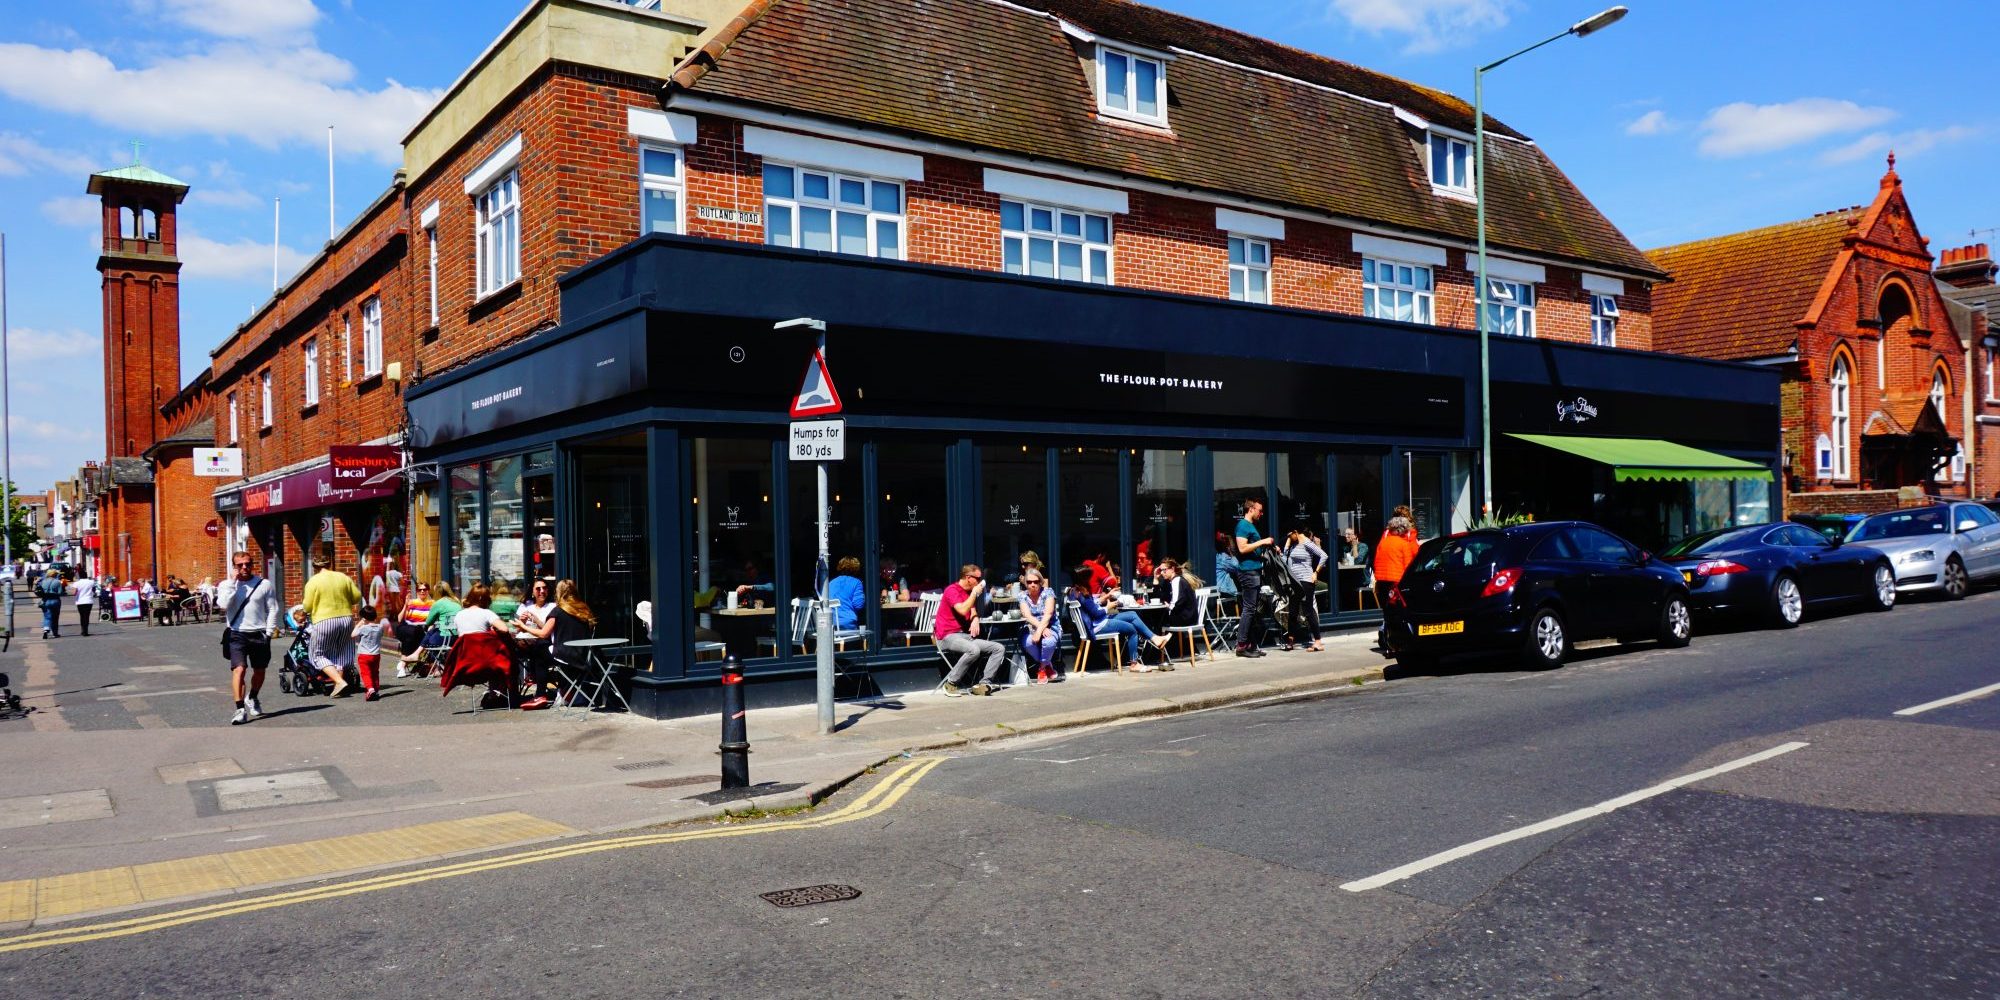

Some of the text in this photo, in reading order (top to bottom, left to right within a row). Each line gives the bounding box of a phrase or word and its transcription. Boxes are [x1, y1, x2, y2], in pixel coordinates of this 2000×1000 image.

[700, 207, 758, 224] RUTLAND ROAD
[1100, 373, 1223, 390] THE FLOUR POT BAKERY
[471, 386, 522, 410] THE FLOUR POT BAKERY
[793, 426, 839, 440] Humps for
[796, 444, 832, 458] 180 yds
[334, 456, 397, 469] Sainsbury's
[335, 467, 366, 478] Local
[269, 481, 283, 507] Local
[1422, 623, 1442, 634] BF59
